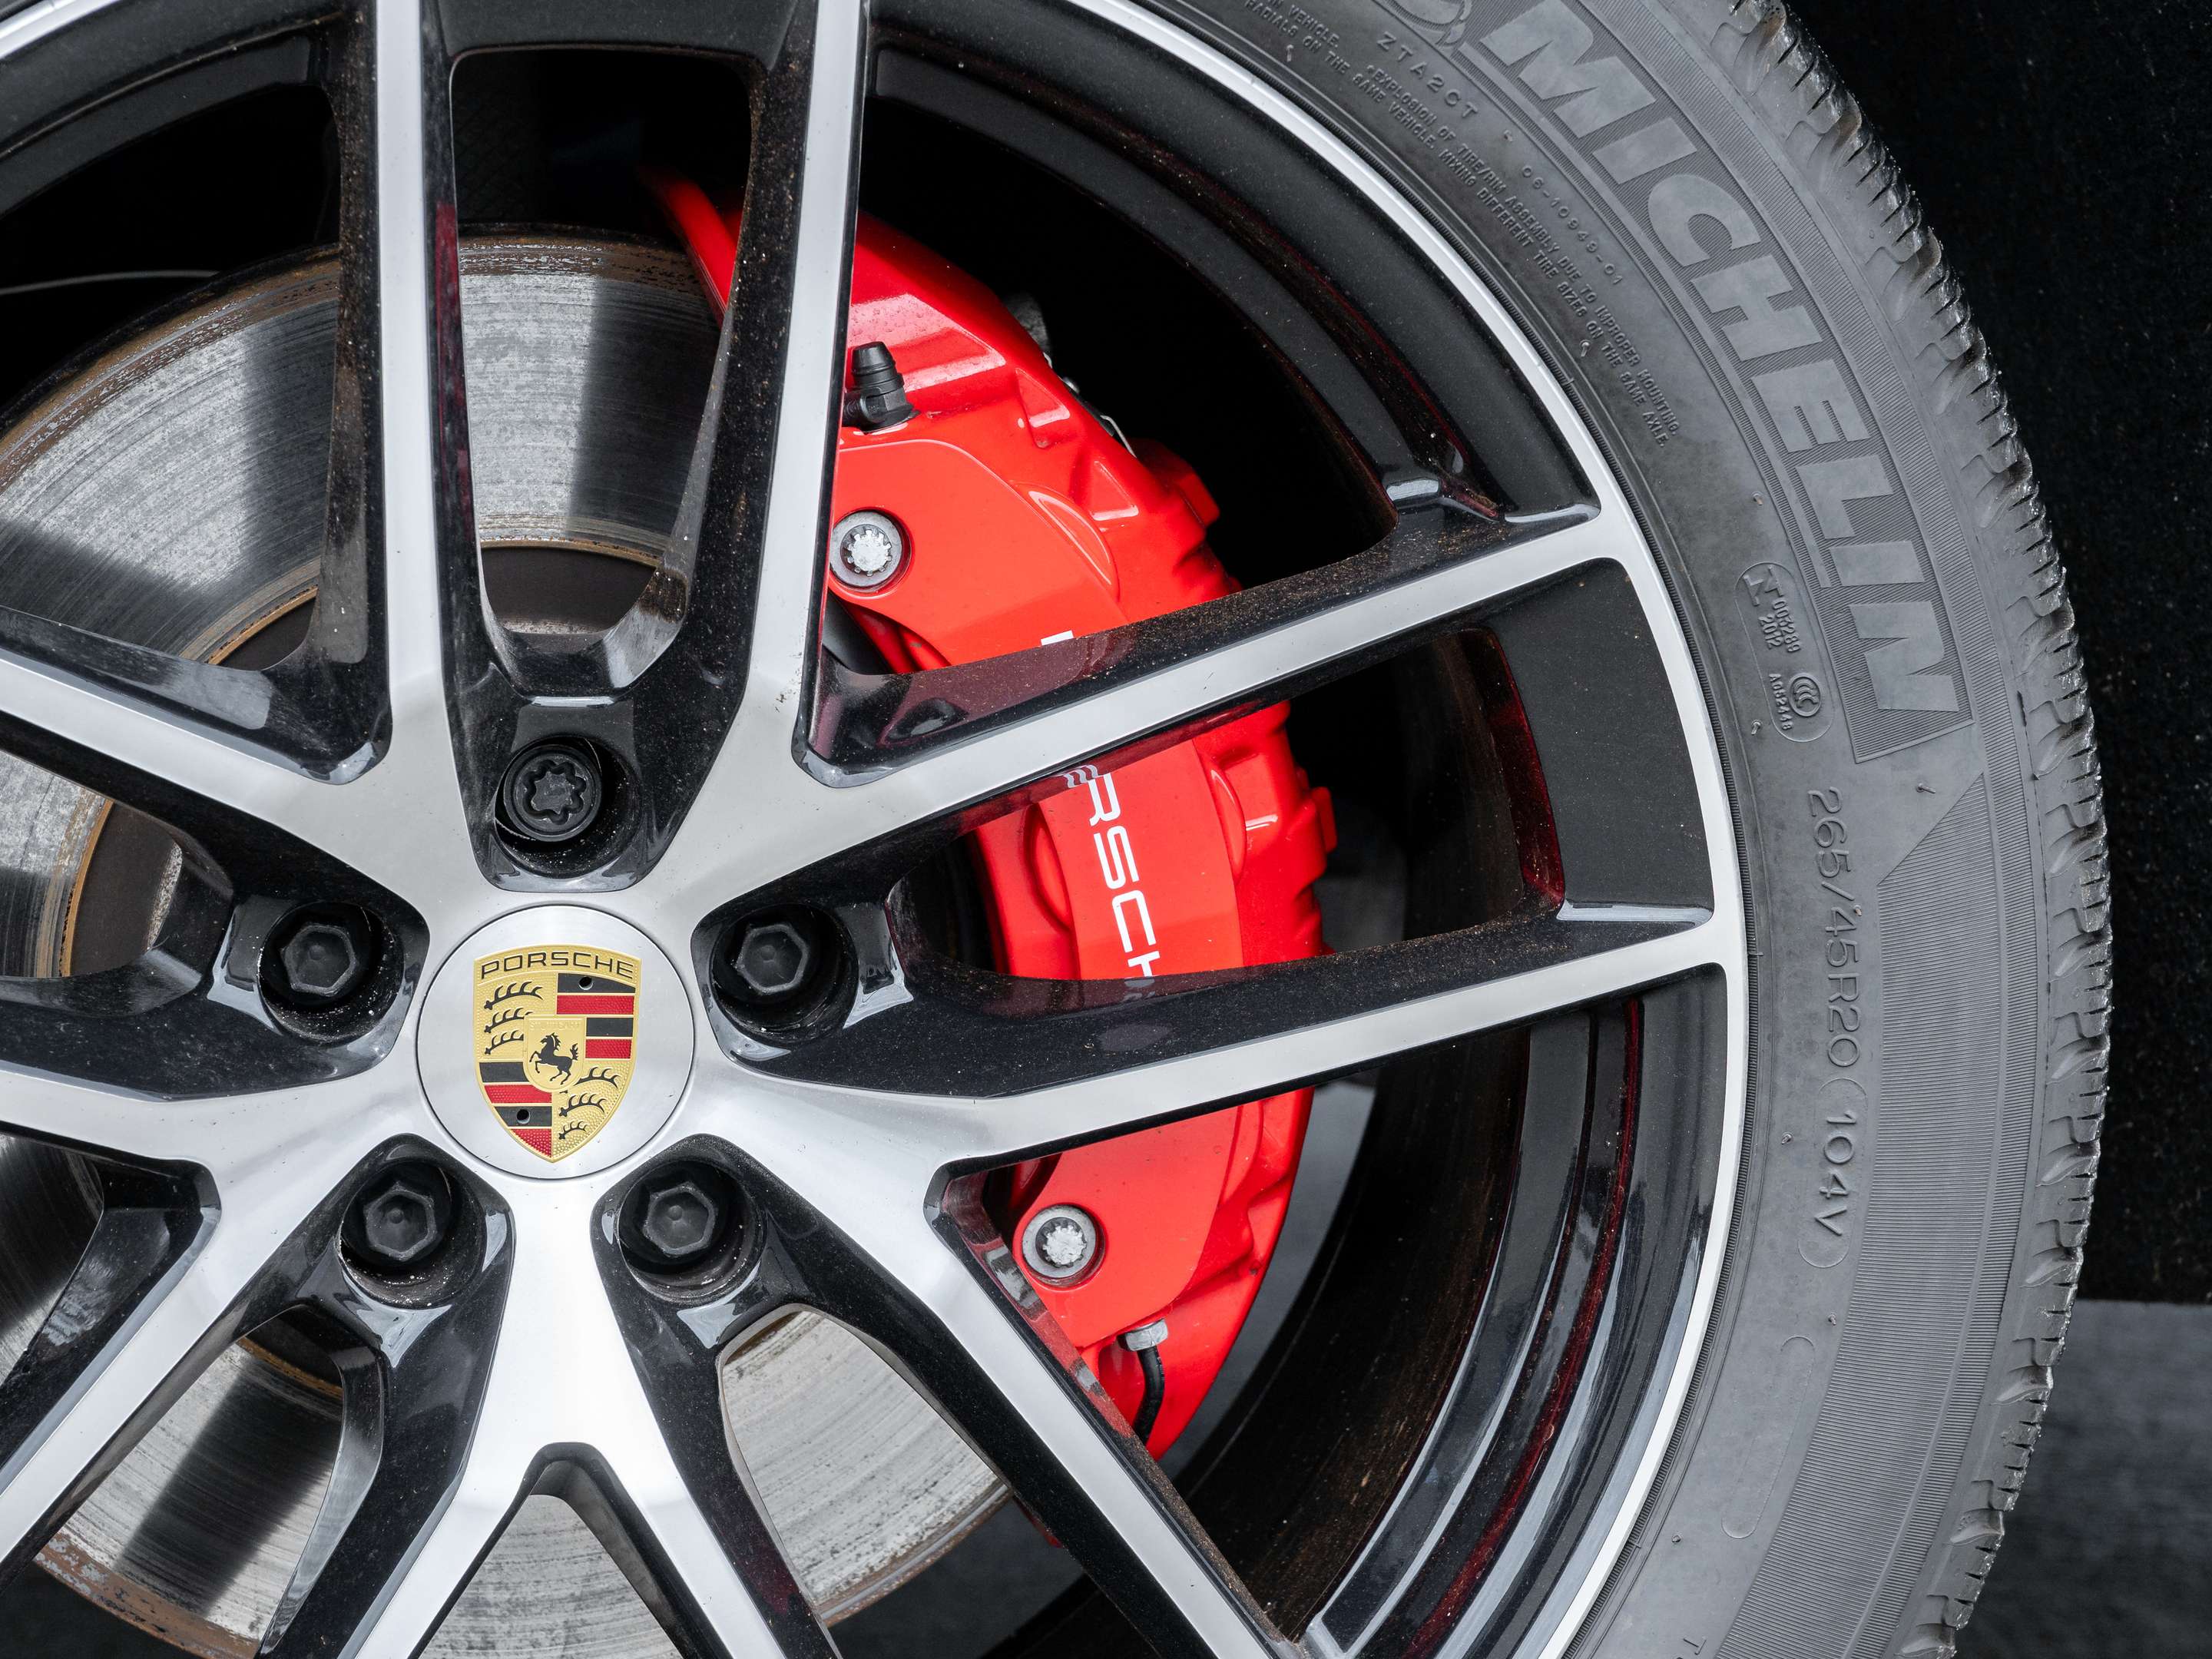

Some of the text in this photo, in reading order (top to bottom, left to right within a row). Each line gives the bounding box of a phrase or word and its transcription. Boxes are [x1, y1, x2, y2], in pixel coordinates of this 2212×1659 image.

[1288, 5, 1339, 48] VEHICLE.
[1373, 68, 1437, 127] EXPLOSION
[1437, 126, 1456, 142] OF
[1458, 143, 1506, 194] TIRE/RIM
[1505, 196, 1560, 253] ASSEMBLY
[1558, 256, 1581, 282] DUE
[1581, 283, 1598, 303] TO
[1594, 305, 1641, 366] IMPROPER
[1637, 369, 1679, 435] MOUNTING.
[1303, 35, 1321, 53] ON
[1325, 50, 1350, 74] THE
[1353, 73, 1386, 102] SAME
[1389, 101, 1435, 149] VEHICLE.
[1439, 149, 1476, 187] MIXING
[1476, 187, 1534, 247] DIFFERENT
[1534, 250, 1559, 279] TIRE
[1558, 281, 1587, 317] SIZES
[1586, 320, 1604, 339] ON
[1601, 342, 1623, 368] THE
[1620, 372, 1647, 406] SAME
[1643, 411, 1669, 448] AXLE.
[1479, 0, 1959, 713] MICHELIN
[1758, 614, 1784, 650] 2012
[482, 952, 633, 979] PORSCHE
[1808, 787, 1861, 1068] 265/45R20
[1815, 1110, 1856, 1236] 104V
